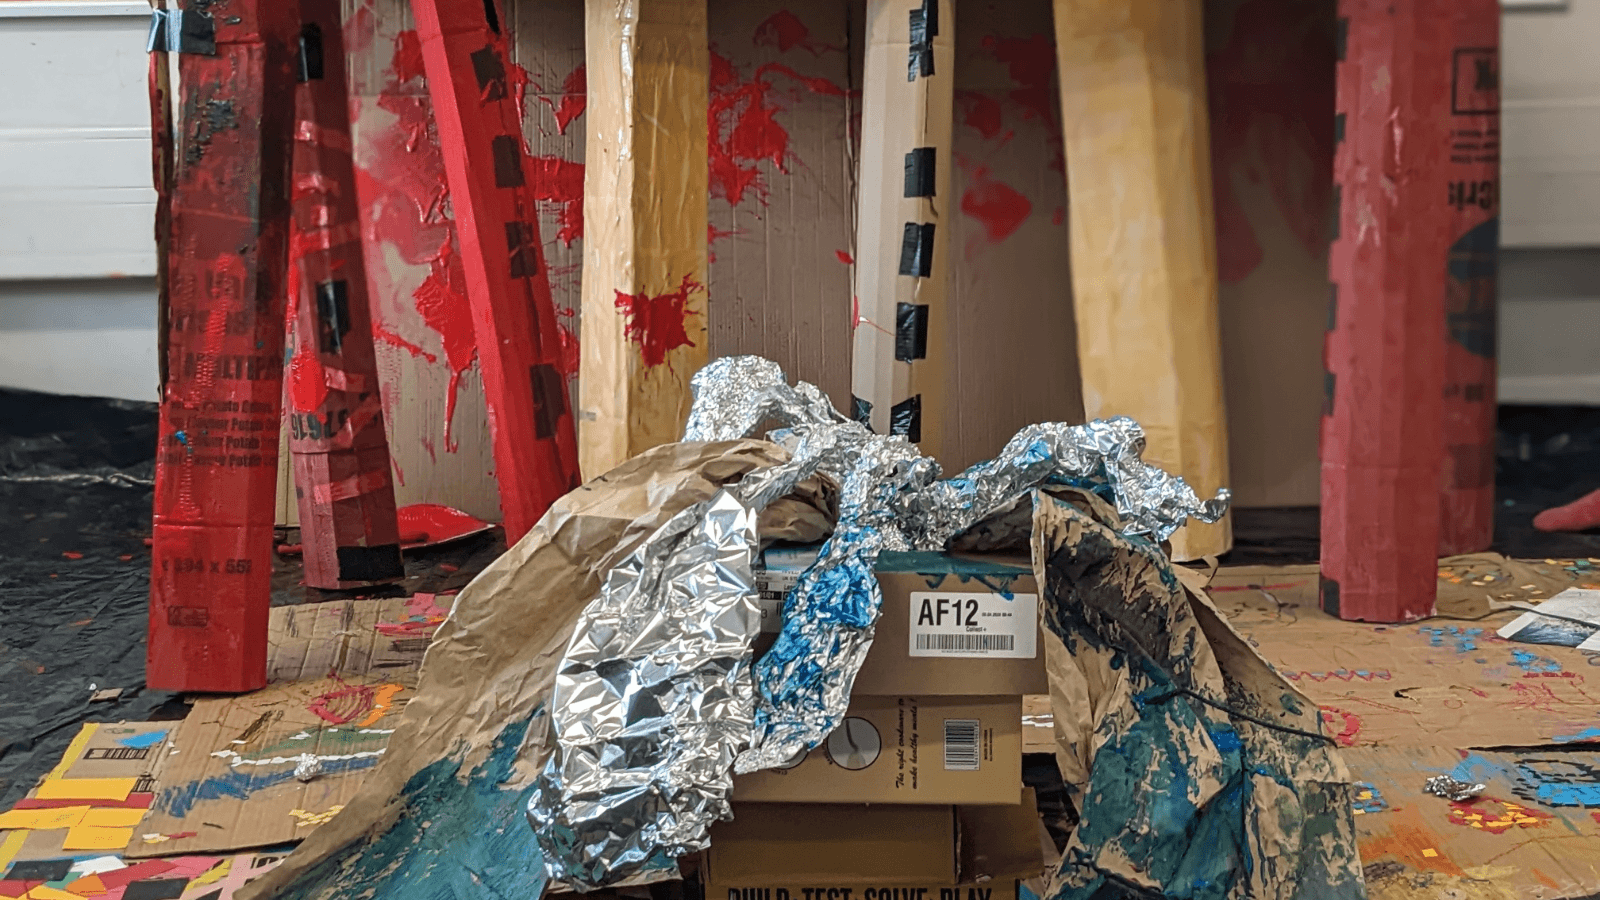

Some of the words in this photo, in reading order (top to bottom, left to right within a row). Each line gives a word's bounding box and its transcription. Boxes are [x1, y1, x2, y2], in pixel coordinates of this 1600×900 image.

[918, 598, 979, 626] AF12
[908, 733, 919, 764] healthy
[895, 772, 905, 789] The
[728, 887, 789, 900] BUILD
[802, 887, 852, 900] TEST
[864, 887, 928, 900] SOLVE
[940, 887, 992, 900] PLAY
